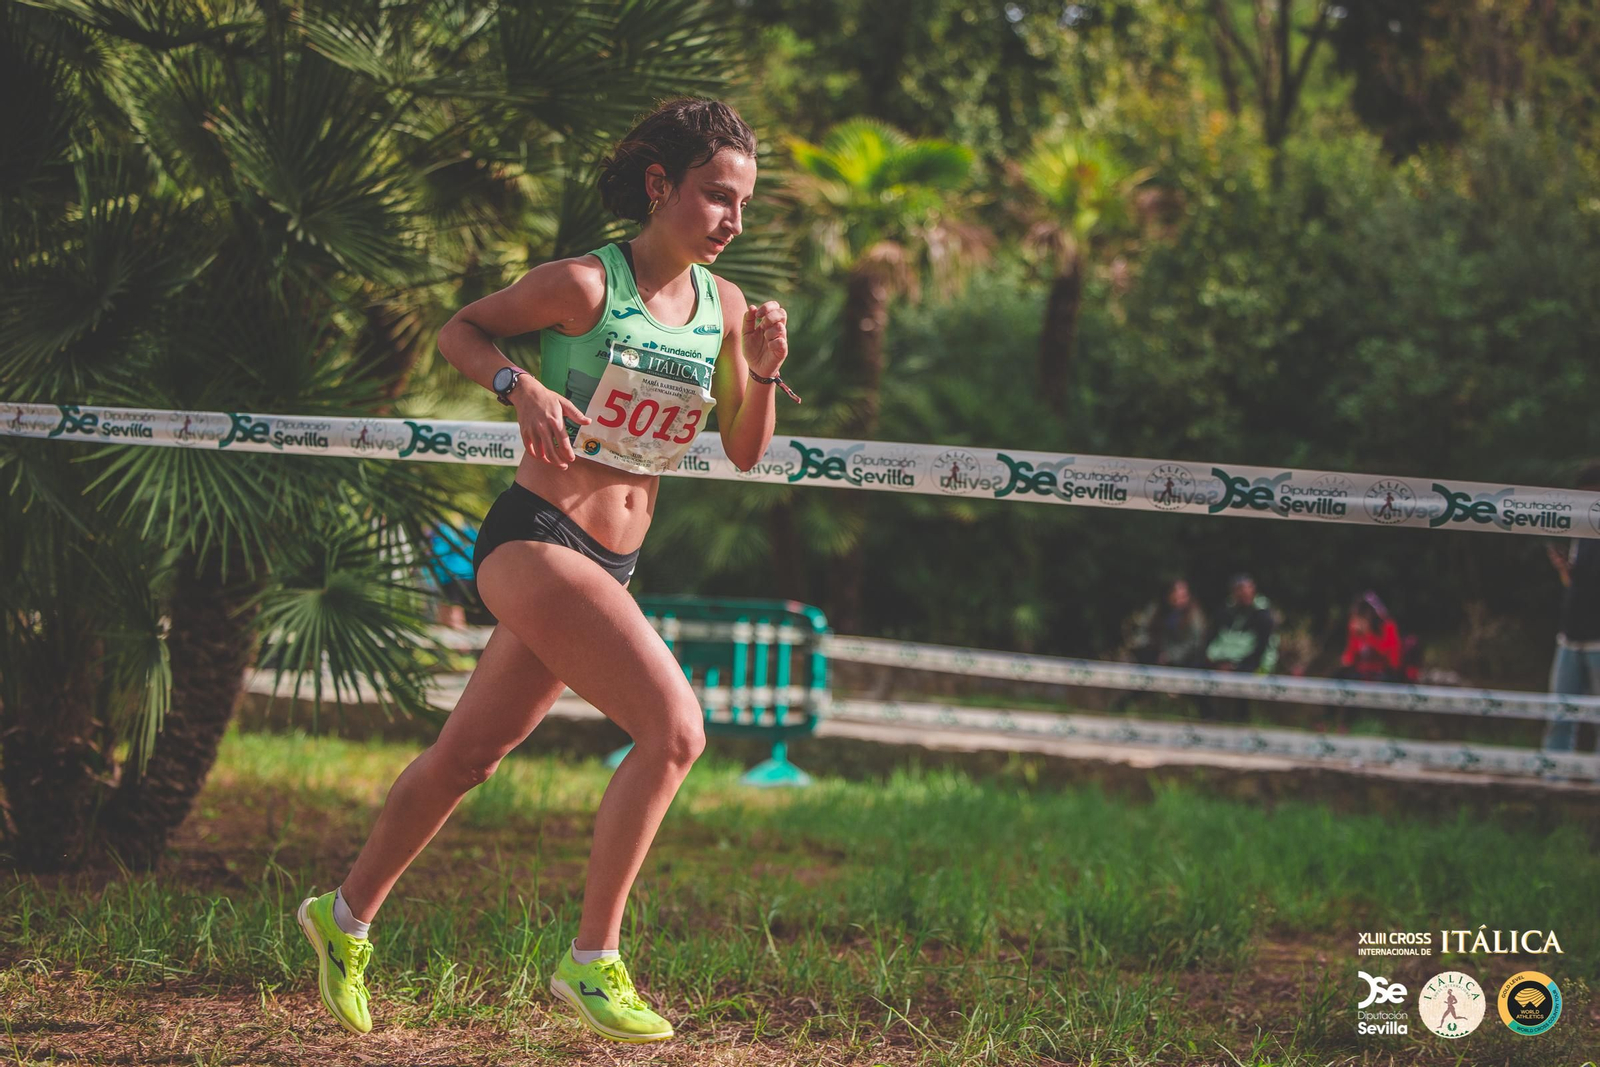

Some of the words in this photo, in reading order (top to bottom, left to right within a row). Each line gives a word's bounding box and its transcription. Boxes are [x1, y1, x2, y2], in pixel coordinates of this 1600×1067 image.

[660, 344, 702, 359] Fundación
[648, 357, 699, 380] ITÁLICA
[104, 410, 155, 422] Diputación
[597, 389, 702, 444] 5013
[102, 422, 153, 439] Sevilla
[458, 430, 516, 443] Diputación
[274, 431, 329, 448] Sevilla
[457, 441, 514, 459] Sevilla
[853, 454, 916, 468] Diputación
[852, 467, 915, 486] Sevilla
[1063, 468, 1129, 483] Diputación
[1062, 481, 1128, 502] Sevilla
[1280, 484, 1348, 499] Diputación
[1279, 496, 1347, 516] Sevilla
[1503, 499, 1572, 513] Diputación
[1502, 510, 1571, 529] Sevilla
